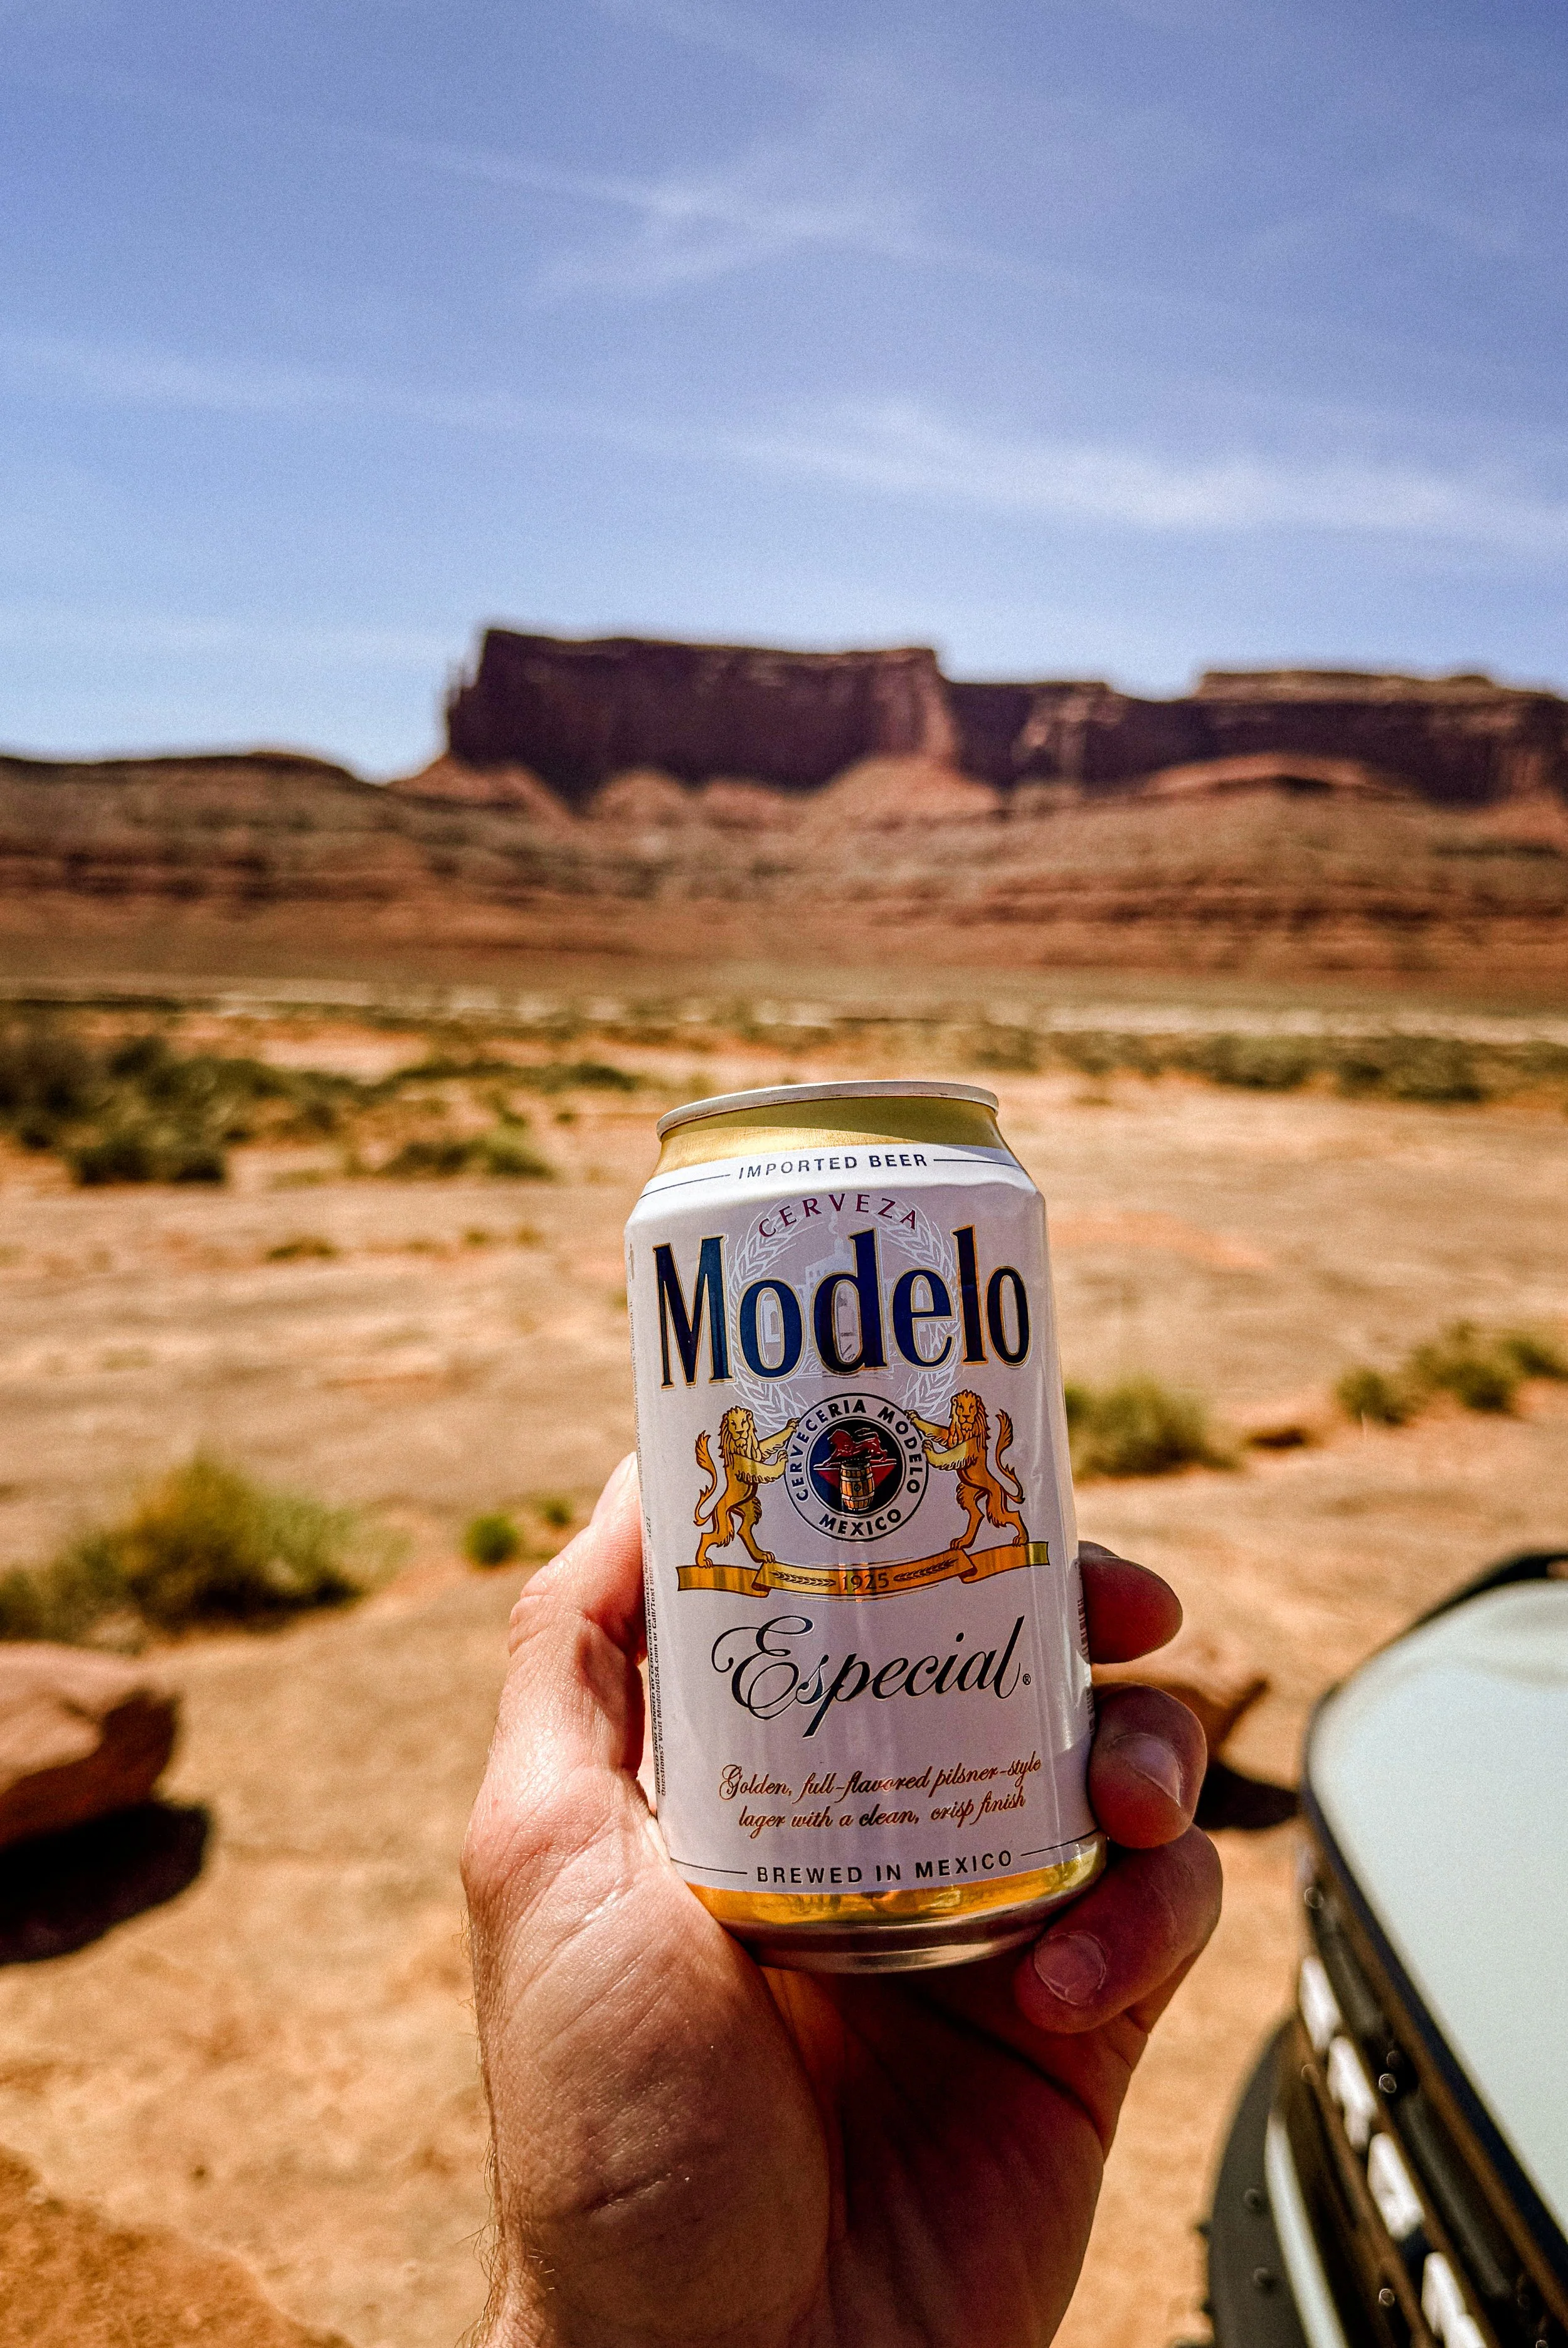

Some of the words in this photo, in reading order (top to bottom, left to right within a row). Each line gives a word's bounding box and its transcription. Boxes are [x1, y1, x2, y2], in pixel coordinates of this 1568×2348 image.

[739, 1156, 857, 1179] IMPORTED
[869, 1154, 928, 1167] BEER
[758, 1193, 918, 1238] CERVEZA
[652, 1224, 1032, 1389] Modelo
[790, 1400, 866, 1501] CERVECERIA
[877, 1406, 923, 1494] MODELO
[818, 1509, 901, 1536] MEXICO
[842, 1572, 889, 1591] 1925
[653, 1632, 657, 1641] or
[654, 1644, 662, 1718] ModeloUSA.com
[719, 1764, 792, 1800] Golden,
[792, 1765, 933, 1804] full-flavored
[928, 1750, 1041, 1798] pilsner-style
[738, 1805, 786, 1839] lager
[791, 1805, 834, 1827] with
[839, 1814, 854, 1827] a
[859, 1803, 919, 1827] clean,
[930, 1798, 975, 1828] crisp
[968, 1785, 1026, 1825] finish
[756, 1866, 862, 1883] BREWED
[876, 1864, 901, 1882] IN
[915, 1850, 1012, 1879] MEXICO
